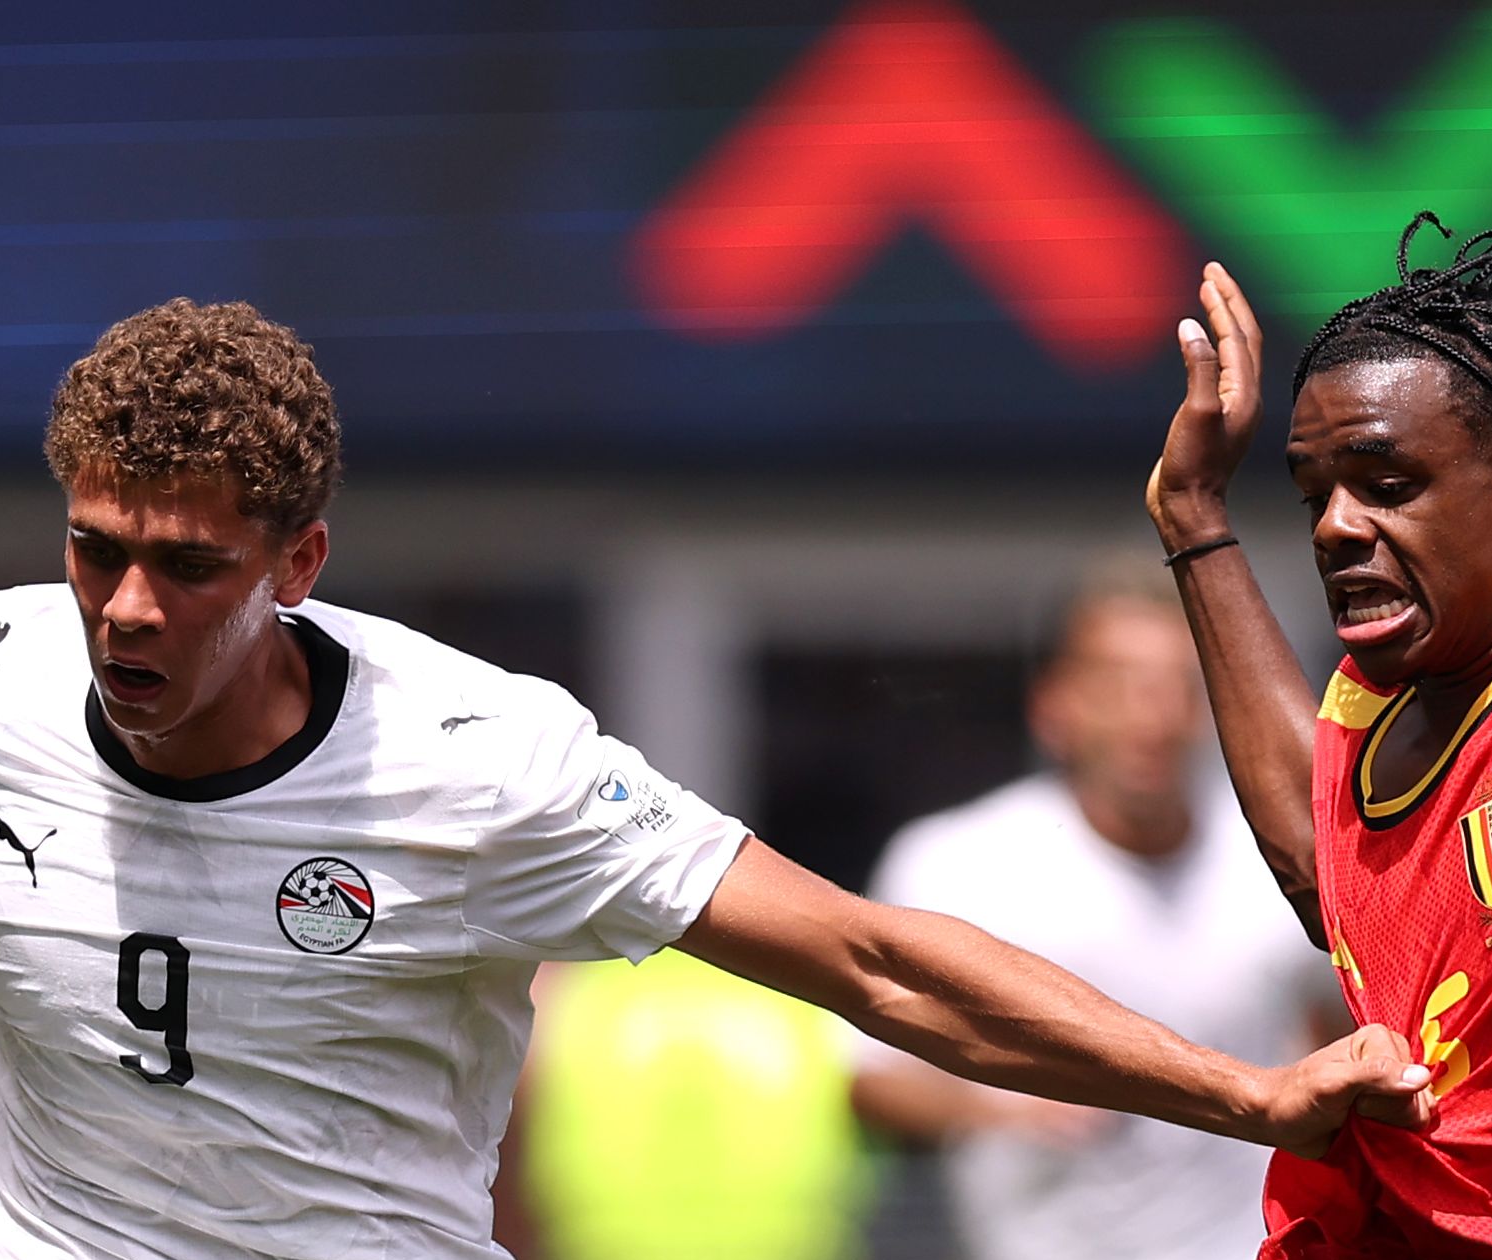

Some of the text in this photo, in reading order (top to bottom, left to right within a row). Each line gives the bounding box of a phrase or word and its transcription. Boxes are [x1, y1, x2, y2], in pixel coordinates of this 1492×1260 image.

[635, 792, 668, 830] PEACE
[650, 812, 673, 832] FIFA
[299, 933, 346, 948] EGYPTIAN FA
[117, 931, 195, 1087] 9
